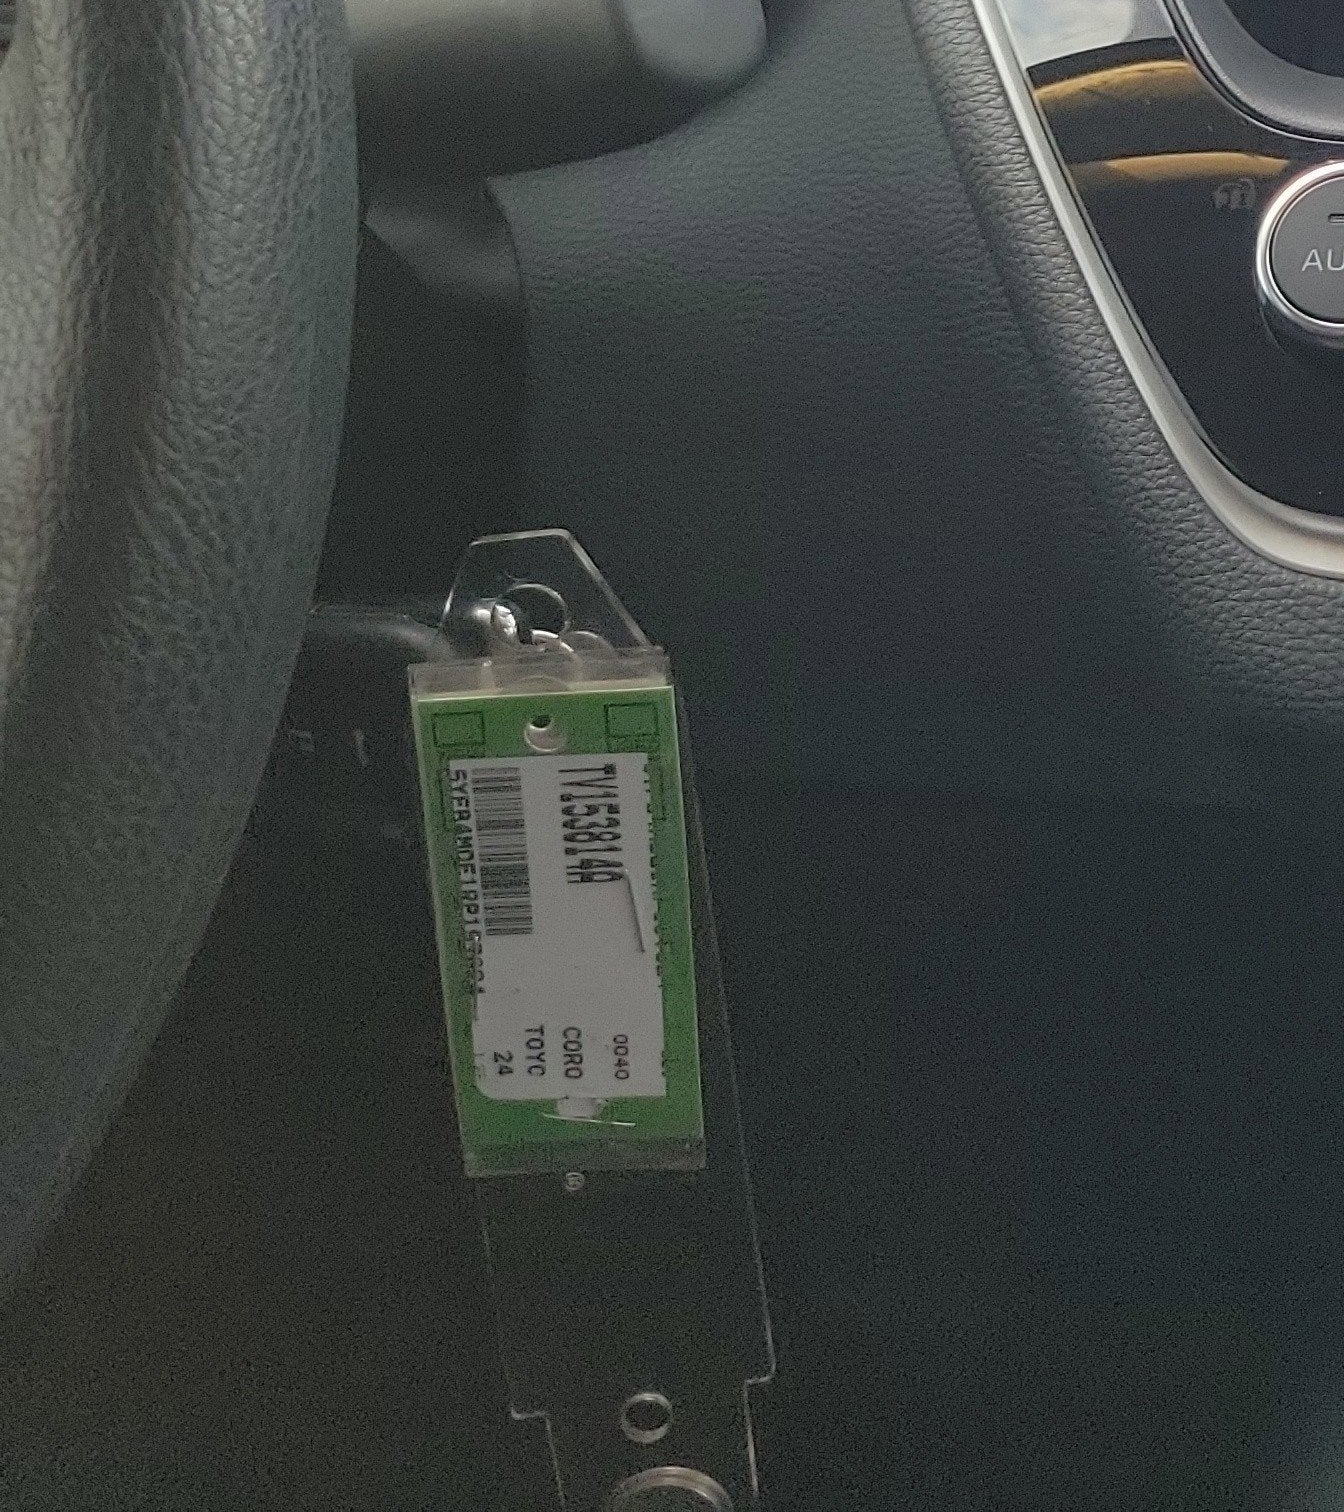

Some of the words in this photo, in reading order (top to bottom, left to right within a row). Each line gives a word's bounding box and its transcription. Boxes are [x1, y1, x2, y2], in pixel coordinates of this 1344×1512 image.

[558, 763, 625, 884] TV153814A
[493, 1050, 514, 1077] 24
[563, 1026, 583, 1080] CORO
